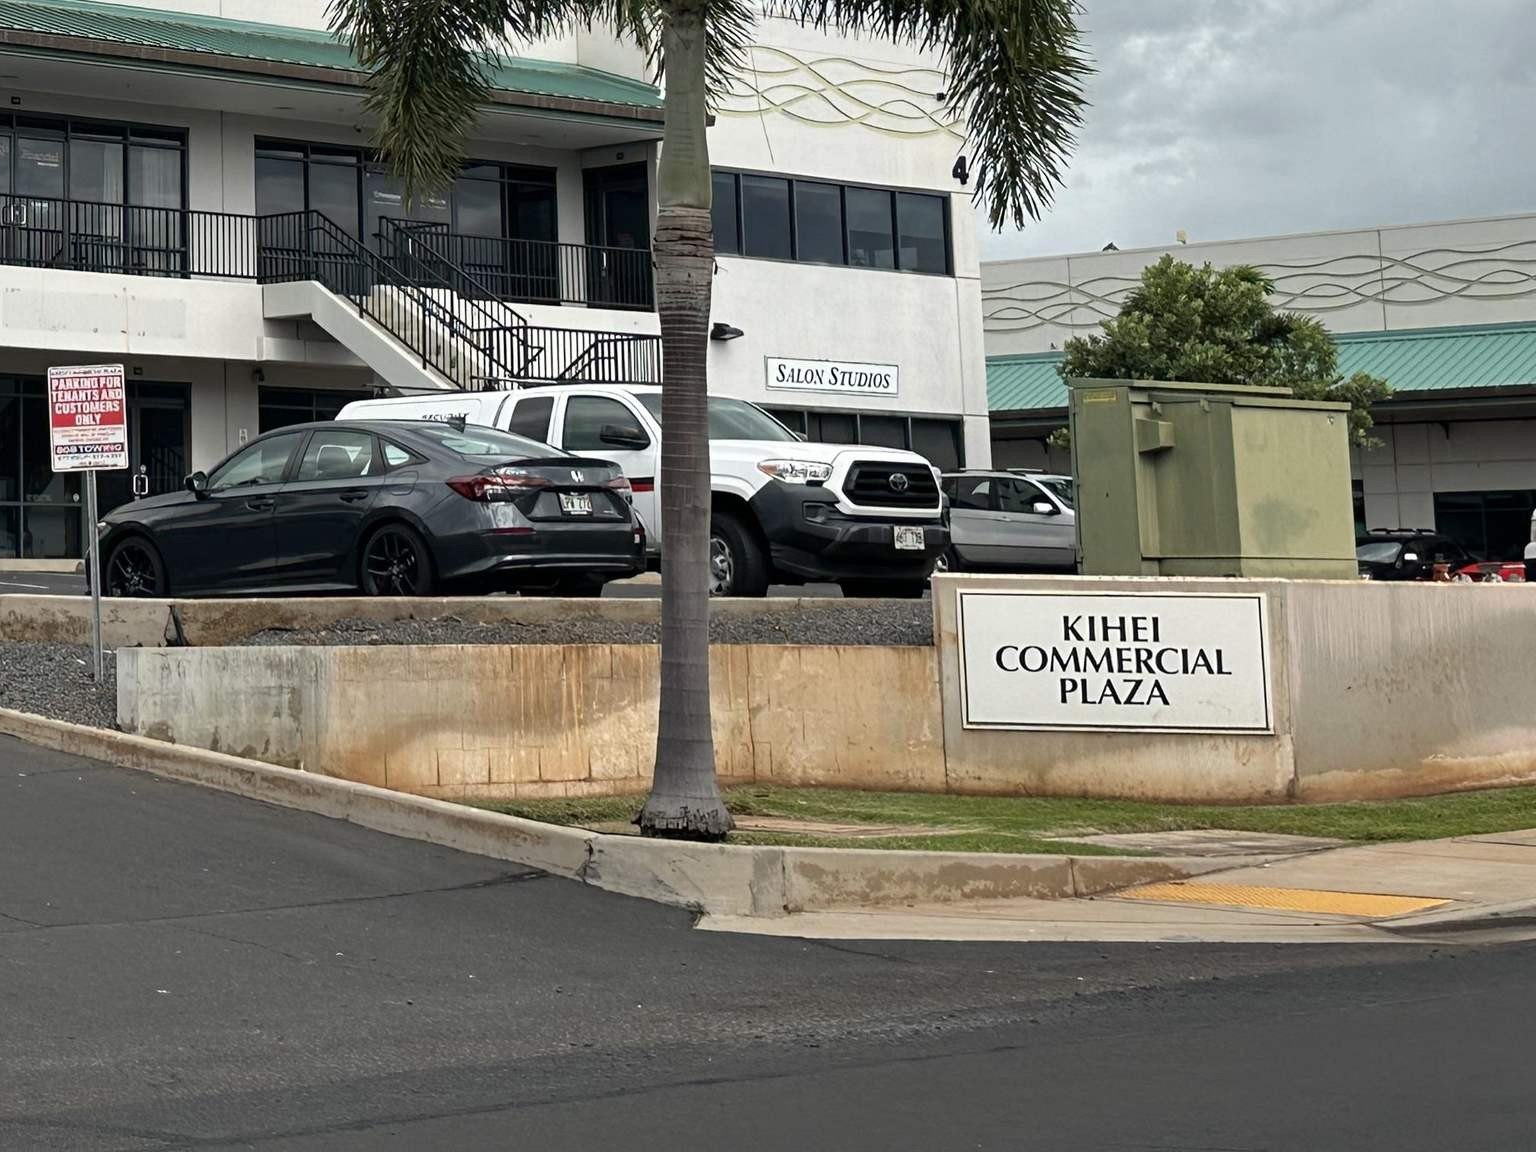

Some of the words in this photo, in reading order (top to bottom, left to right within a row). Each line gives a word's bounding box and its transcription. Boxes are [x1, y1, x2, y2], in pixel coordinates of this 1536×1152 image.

[51, 377, 98, 390] PARKING
[99, 376, 121, 388] FOR
[51, 390, 99, 403] TENANTS
[100, 388, 123, 400] AND
[55, 400, 120, 415] CUSTOMERS
[75, 413, 102, 425] ONLY
[1062, 615, 1160, 643] KIHEI
[995, 645, 1232, 675] COMMERCIAL
[1060, 677, 1170, 706] PLAZA
